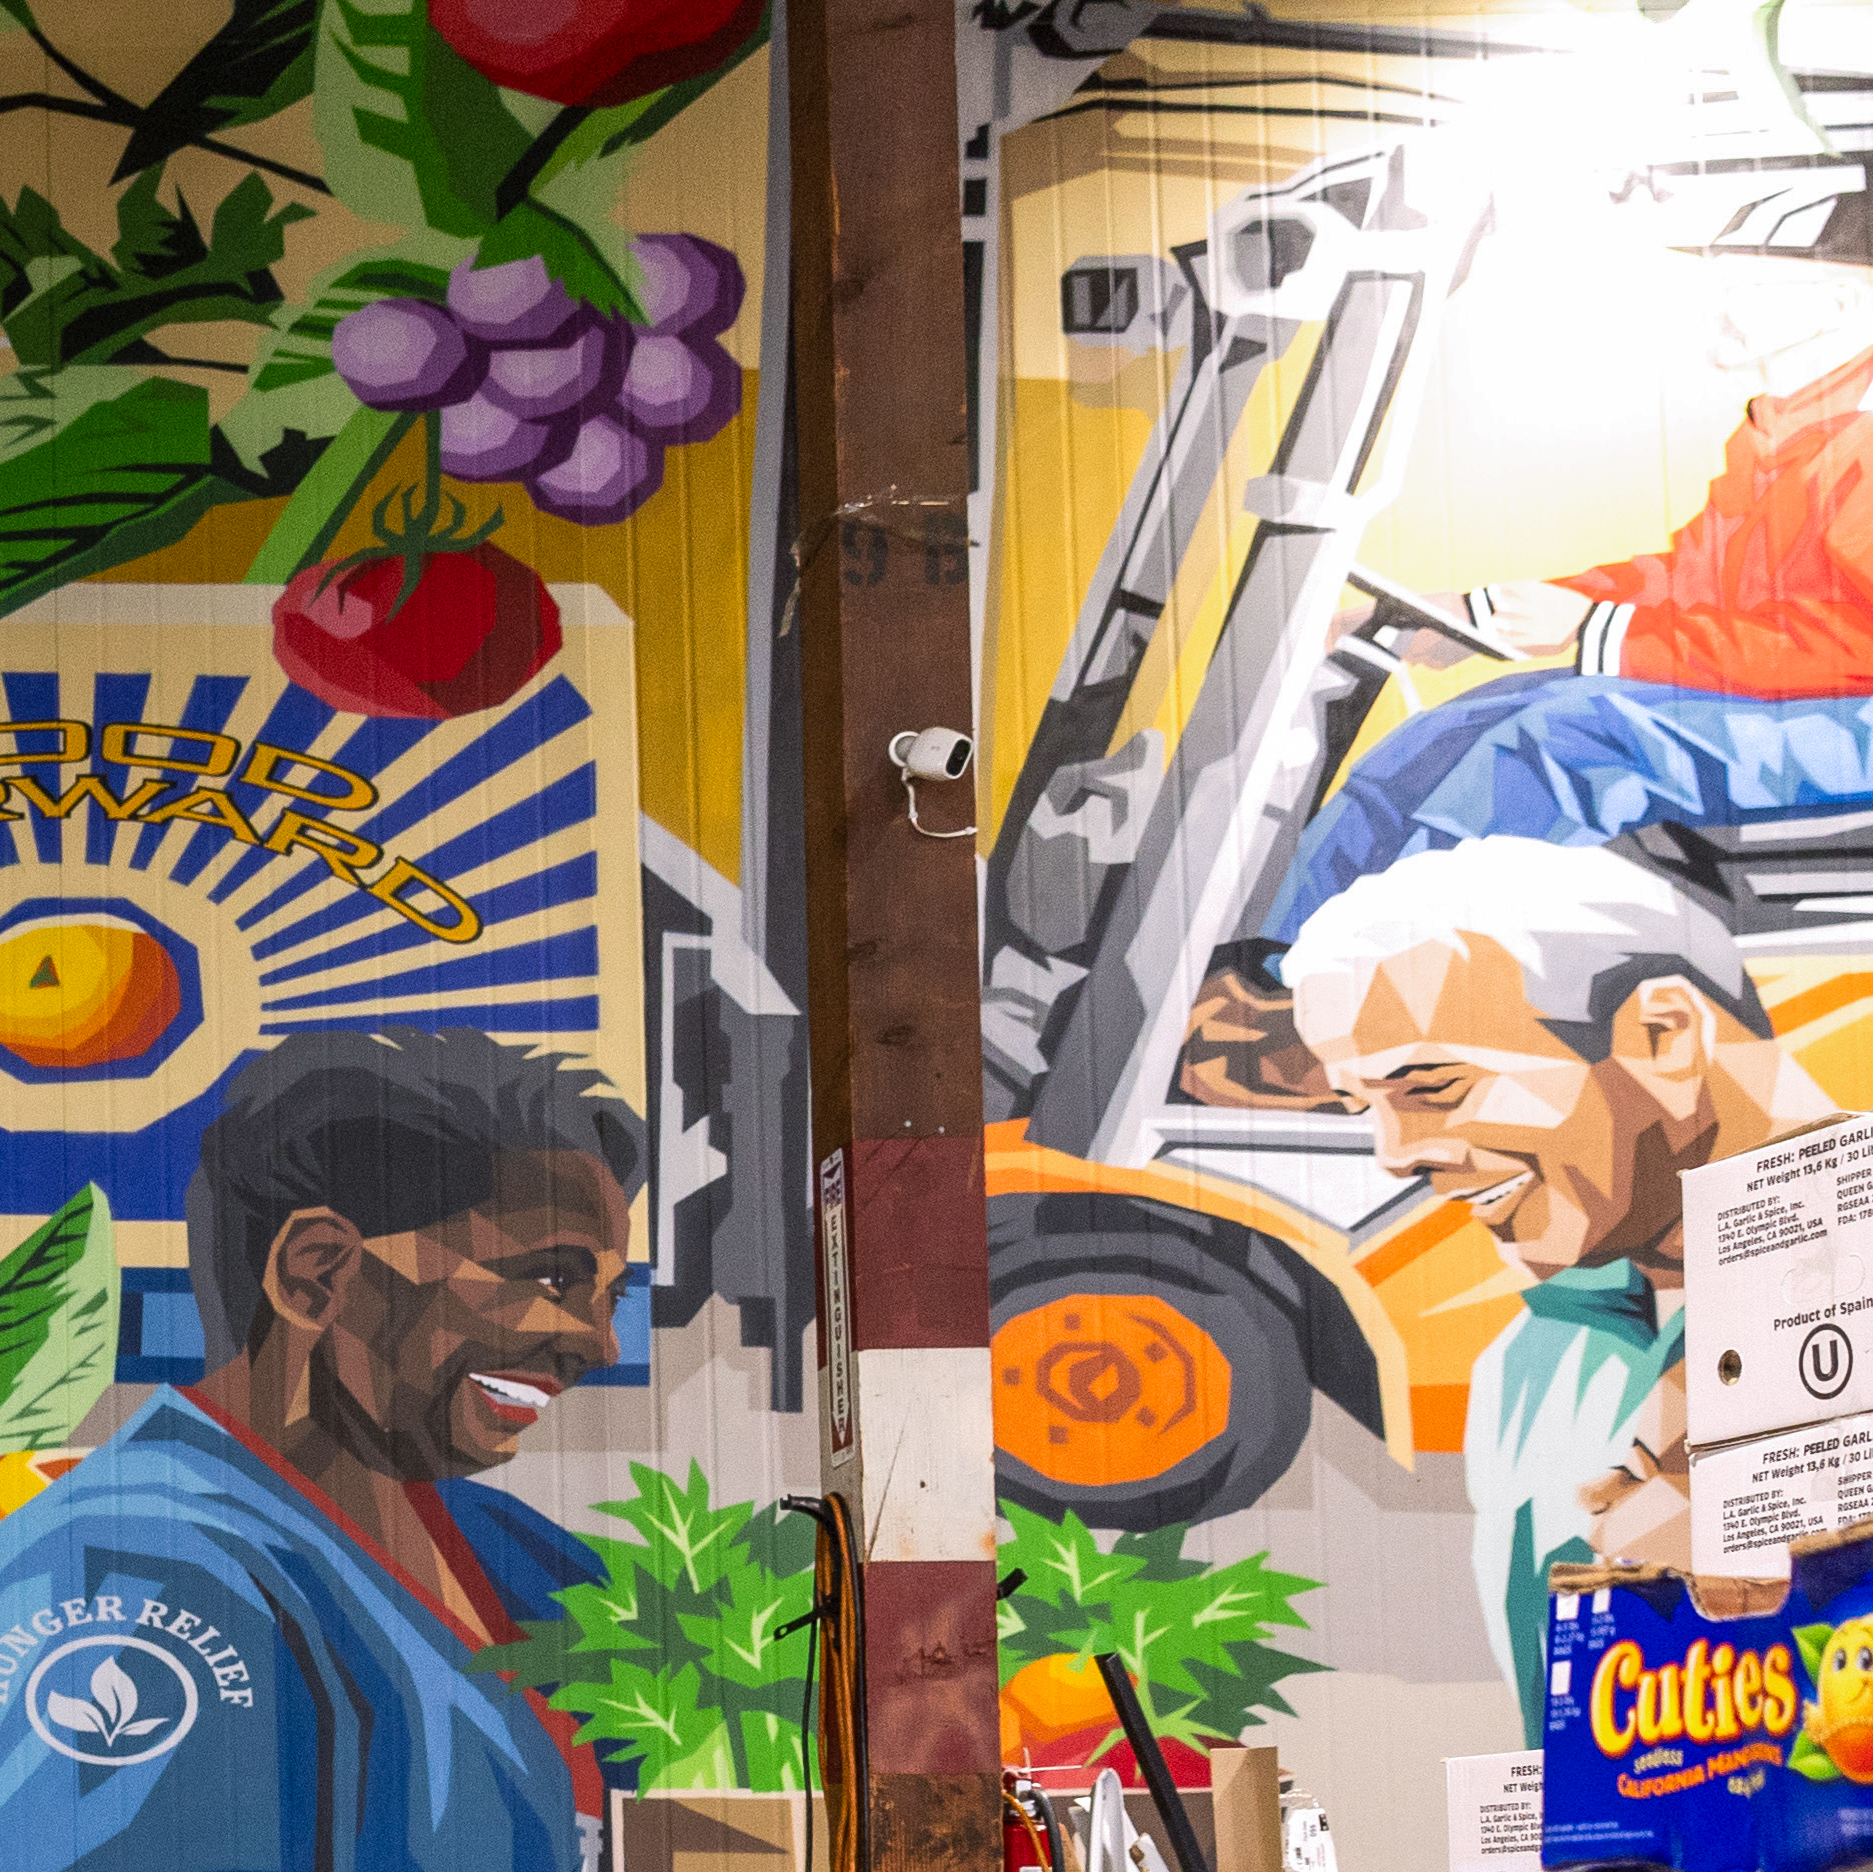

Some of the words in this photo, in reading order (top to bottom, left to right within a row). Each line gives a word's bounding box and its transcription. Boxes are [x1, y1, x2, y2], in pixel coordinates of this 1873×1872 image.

[1746, 1176, 1763, 1193] NET
[1765, 1167, 1801, 1189] Weight
[1757, 1150, 1794, 1173] FRESH:
[1798, 1139, 1836, 1163] PEELED
[831, 1215, 845, 1432] EXTINGUISHER
[1773, 1306, 1821, 1331] Product
[1824, 1303, 1837, 1318] of
[1840, 1295, 1873, 1321] Spain
[139, 1598, 253, 1708] RELIEF
[1590, 1638, 1798, 1758] Cuties
